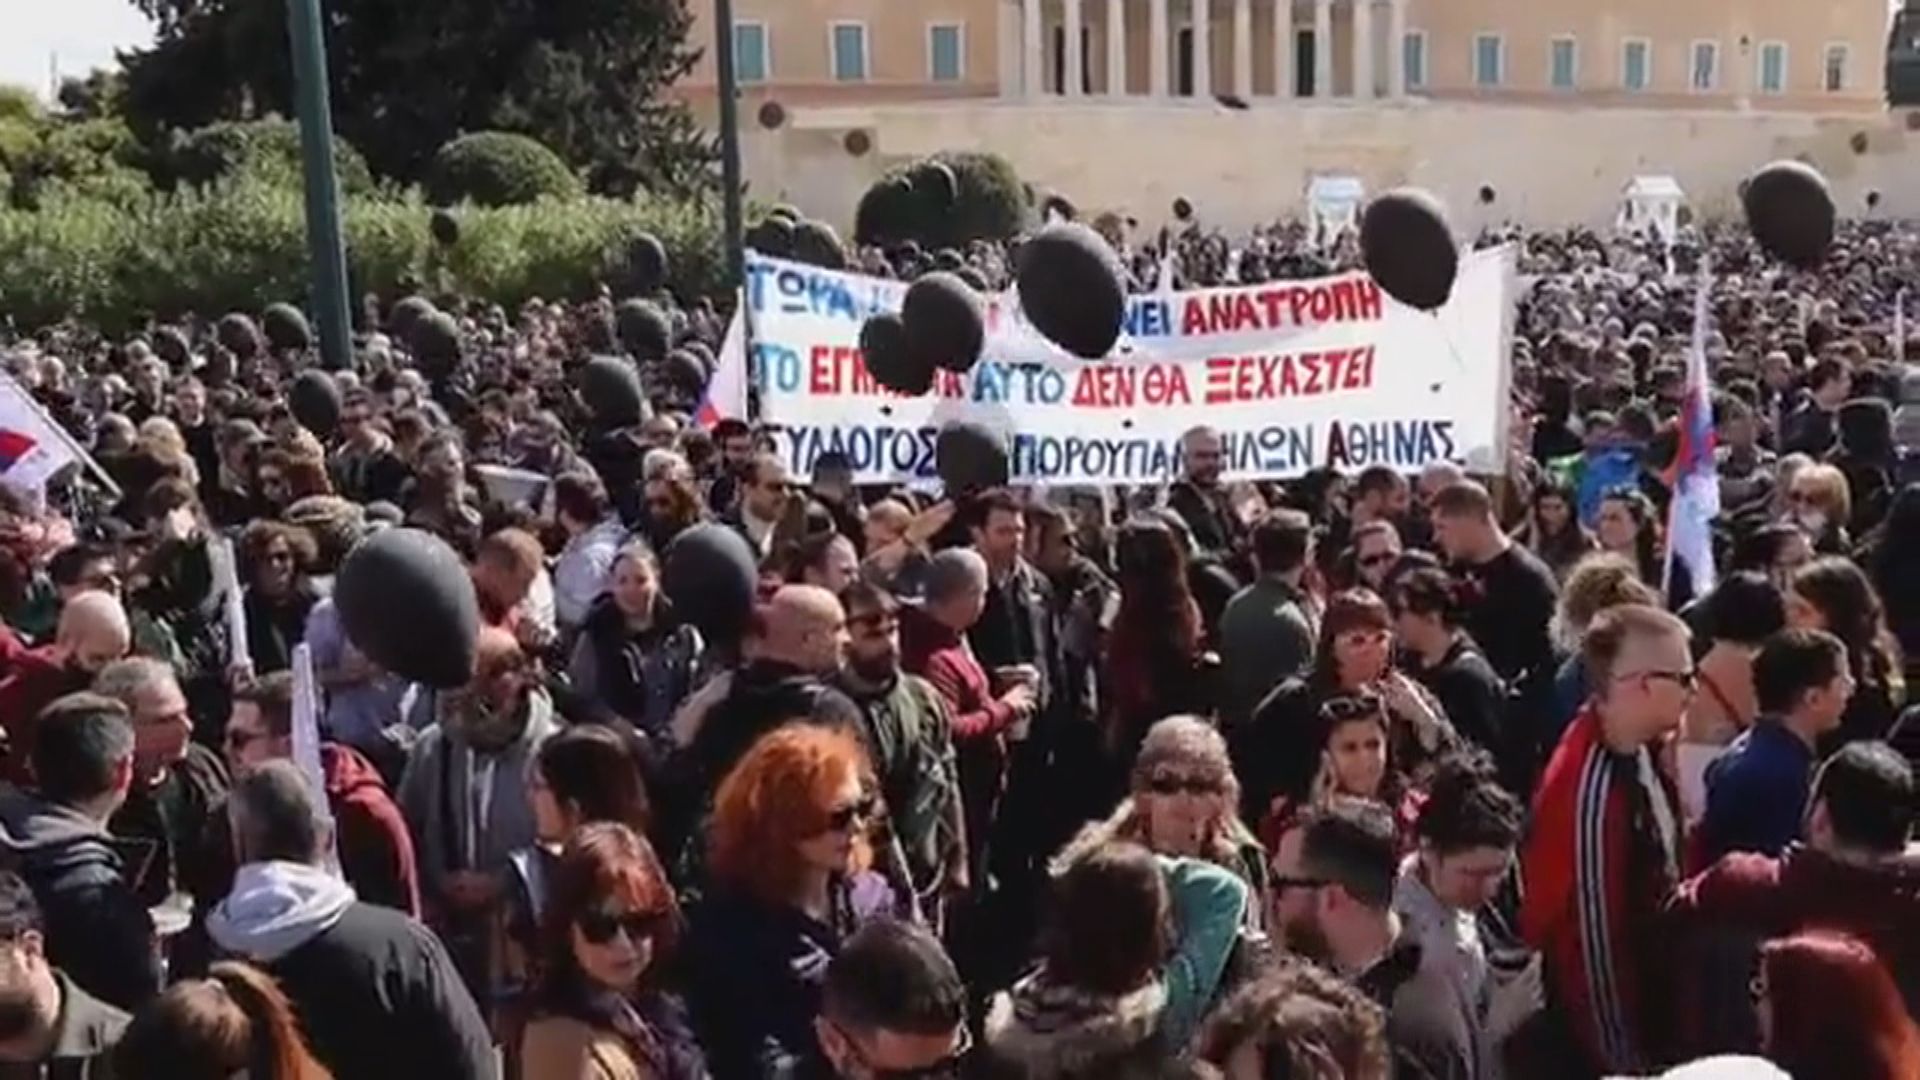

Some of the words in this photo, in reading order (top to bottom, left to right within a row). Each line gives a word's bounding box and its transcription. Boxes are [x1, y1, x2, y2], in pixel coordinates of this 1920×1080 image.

[747, 263, 858, 320] ΤΩΡΑ
[1122, 300, 1171, 337] ΝΕΙ
[1182, 278, 1382, 337] ΑΝΑΤΡΟΠΗ
[755, 343, 800, 393] ΤΟ
[972, 361, 1064, 402] ΑΥΤΟ
[1070, 366, 1137, 409] ΔΕΝ
[1143, 365, 1192, 403] ΘΑ
[1205, 345, 1376, 404] ΞΕΧΑΣΤΕΙ
[1326, 421, 1466, 468] ΑΘΗΝΑΣ
